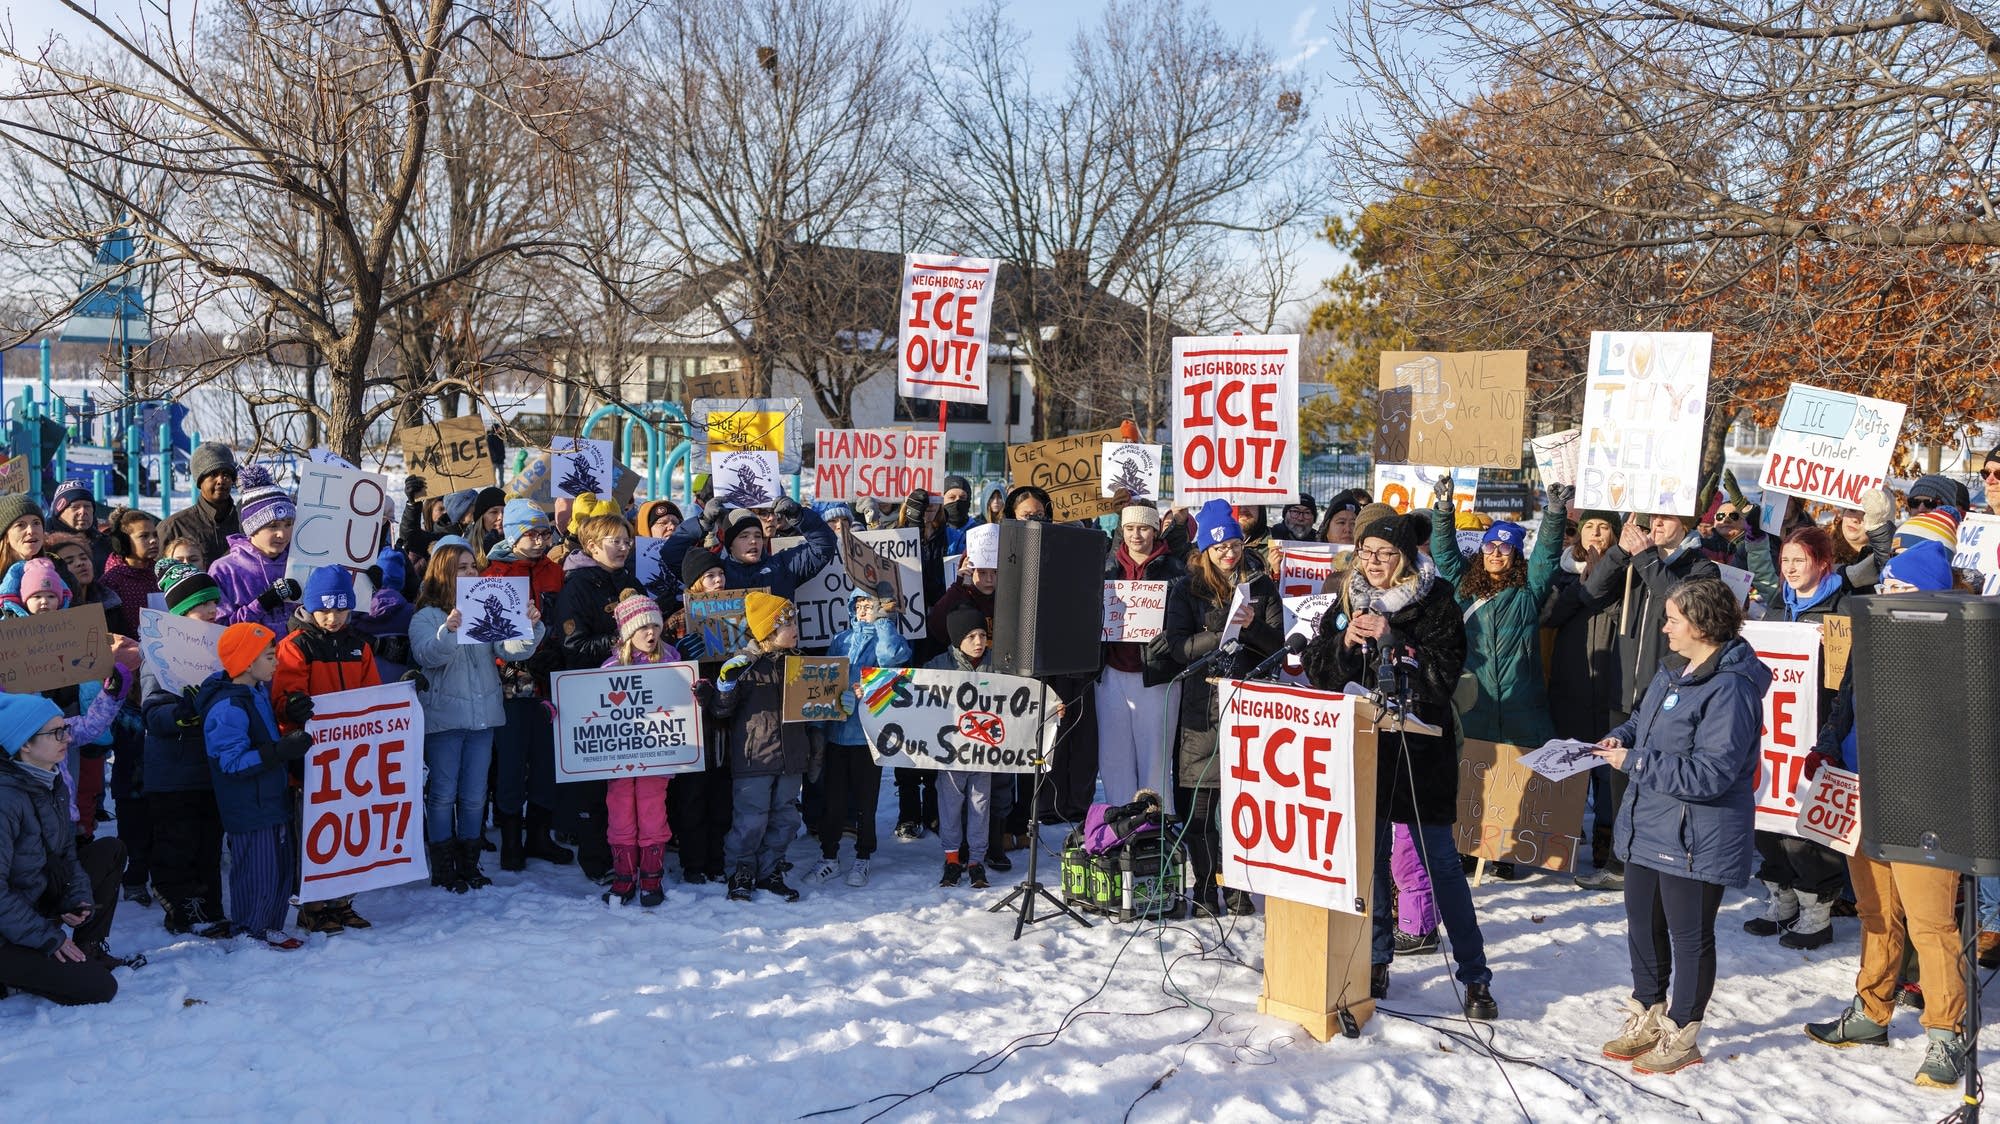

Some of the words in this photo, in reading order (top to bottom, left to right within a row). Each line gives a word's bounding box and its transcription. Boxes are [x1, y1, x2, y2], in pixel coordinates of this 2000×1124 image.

[912, 275, 964, 289] NEIGHBORS
[967, 279, 985, 290] SAY
[908, 291, 977, 337] ICE
[906, 335, 980, 382] OUT!
[1184, 362, 1257, 378] NEIGHBORS
[1261, 363, 1285, 376] SAY
[1452, 353, 1499, 390] WE
[1184, 380, 1278, 432] ICE
[1456, 397, 1480, 420] Are
[1490, 390, 1526, 421] NOT
[1594, 382, 1695, 422] THY
[1801, 401, 1830, 428] ICE
[451, 435, 488, 462] ICE
[818, 432, 896, 460] HANDS
[904, 435, 940, 460] OFF
[1014, 445, 1047, 463] GET
[1184, 434, 1287, 485] OUT!
[816, 464, 851, 499] MY
[856, 465, 943, 499] SCHOOL
[880, 539, 918, 560] FROM
[1961, 526, 1984, 546] WE
[470, 578, 502, 594] MINNEAPOLIS
[825, 573, 856, 592] OU
[1285, 566, 1331, 580] NEIGH
[1131, 582, 1164, 592] RATHER
[1108, 596, 1124, 606] IN
[1125, 596, 1164, 610] SCHOOL
[1110, 612, 1137, 621] BUT
[1296, 594, 1327, 613] MINNEAPOLIS
[1829, 620, 1852, 638] Min
[608, 675, 642, 692] WE
[1783, 669, 1804, 684] SAY
[807, 686, 820, 700] IS
[891, 676, 953, 708] STAY
[956, 682, 1007, 714] OUT
[1010, 686, 1040, 718] OF
[610, 708, 646, 721] OUR
[1231, 698, 1310, 725] NEIGHBORS
[1314, 712, 1340, 728] SAY
[312, 720, 384, 746] NEIGHBORS
[387, 718, 410, 732] SAY
[574, 718, 686, 740] IMMIGRANT
[574, 732, 686, 754] NEIGHBORS!
[876, 722, 928, 757] OUR
[934, 724, 1037, 766] SCHOOLS
[310, 740, 406, 804] ICE
[1231, 725, 1332, 801] ICE
[1815, 783, 1859, 816] ICE
[306, 801, 412, 865] OUT!
[1232, 792, 1342, 872] OUT!
[1807, 804, 1857, 839] OUT!
